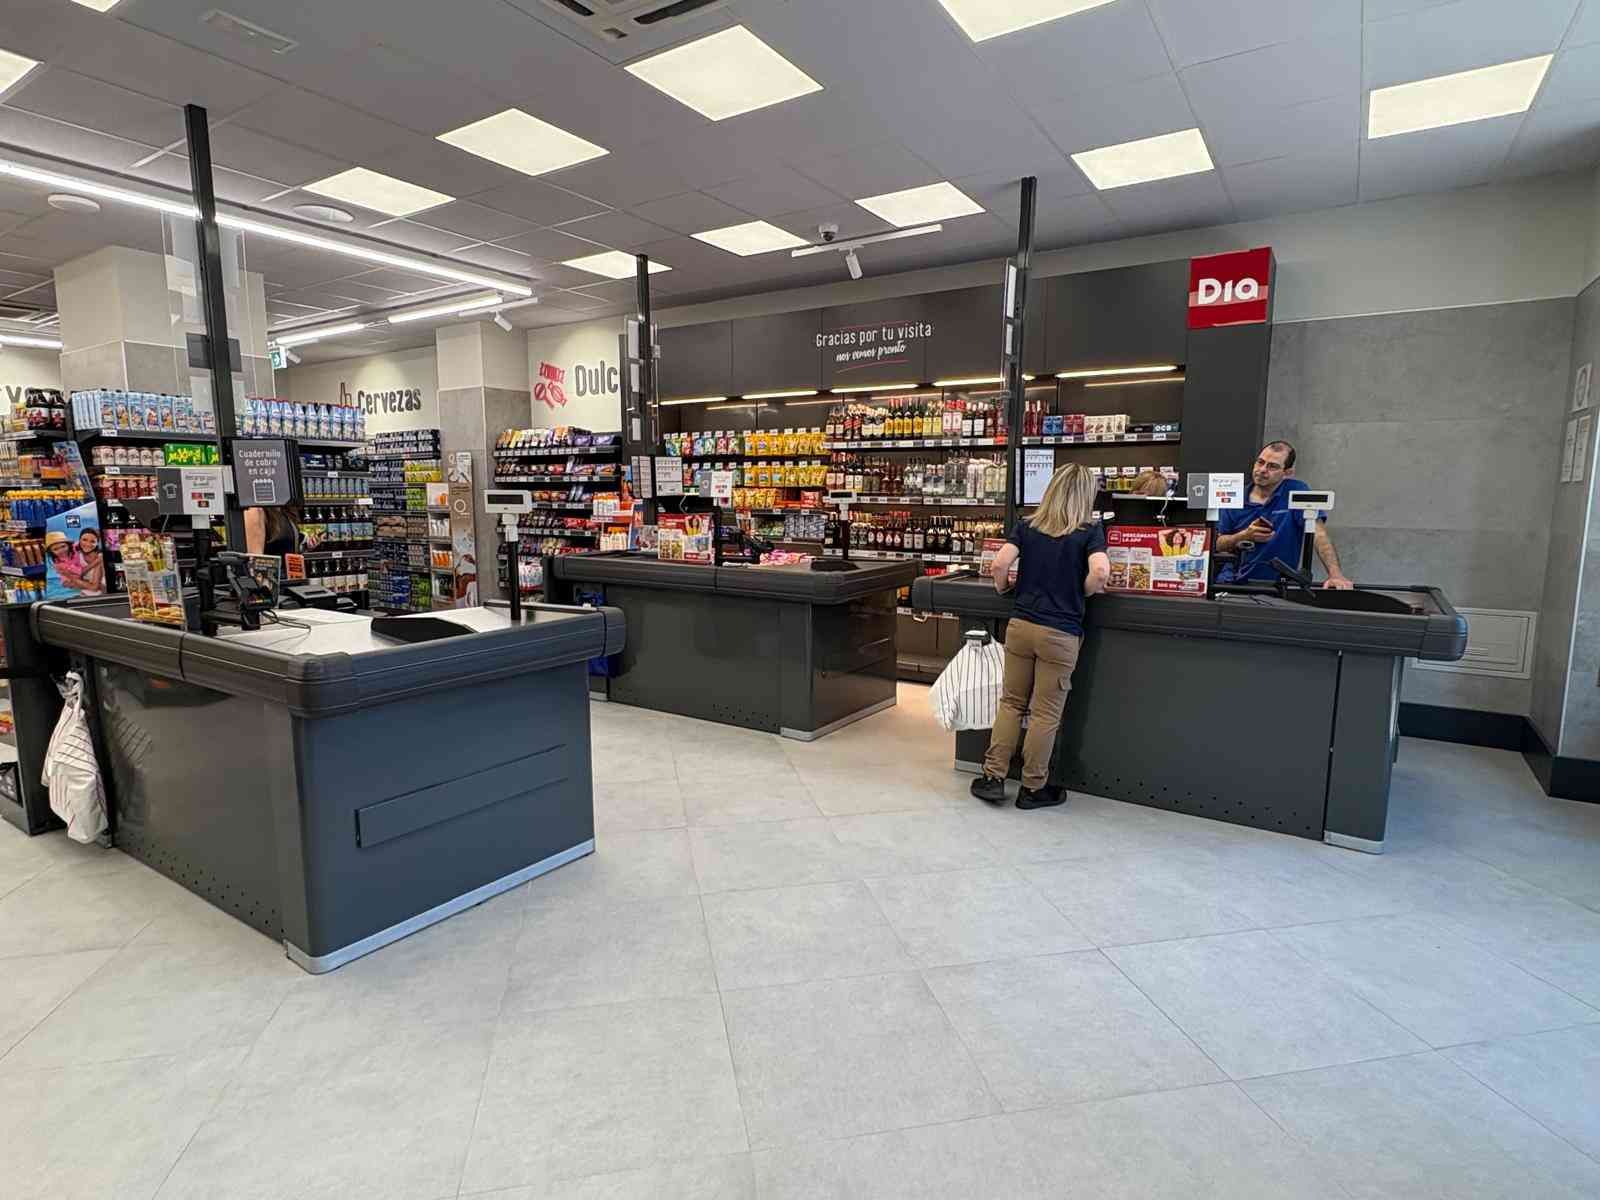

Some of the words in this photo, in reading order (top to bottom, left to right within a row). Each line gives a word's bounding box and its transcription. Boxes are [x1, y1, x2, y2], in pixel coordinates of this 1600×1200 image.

[816, 330, 856, 347] Gracias
[859, 329, 878, 346] por
[882, 326, 894, 340] tu
[898, 322, 932, 339] visita
[836, 351, 851, 362] nos
[852, 347, 876, 361] vemos
[877, 340, 906, 360] pronto
[575, 360, 619, 397] Dulc
[358, 387, 421, 417] Cervezas
[239, 449, 281, 458] Cuadernillo
[244, 458, 254, 467] de
[256, 458, 277, 467] cobro
[248, 467, 258, 475] en
[259, 467, 275, 477] caja
